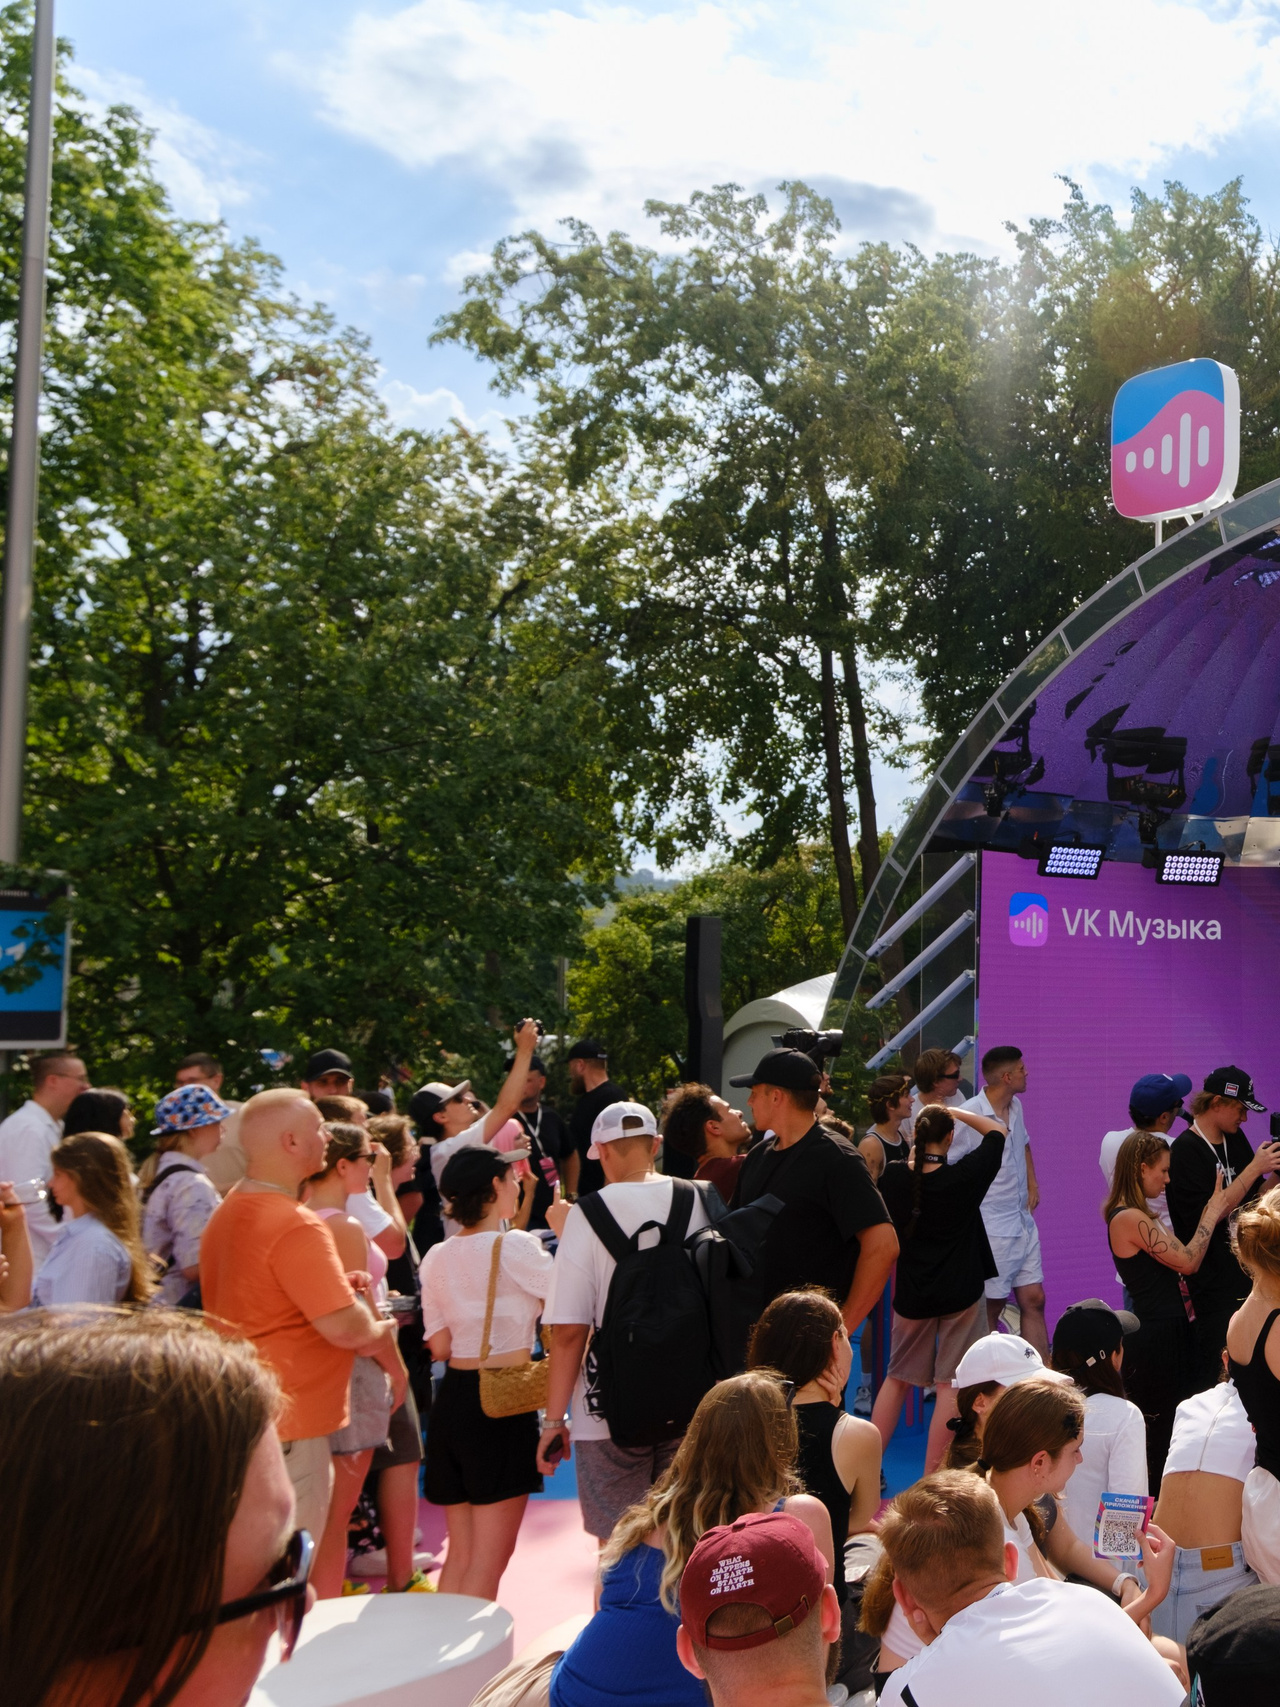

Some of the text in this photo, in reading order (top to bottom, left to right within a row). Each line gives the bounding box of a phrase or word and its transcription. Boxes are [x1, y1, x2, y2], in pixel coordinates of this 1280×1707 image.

[1062, 908, 1222, 946] VK Музыка
[712, 1560, 751, 1575] HAPPENS
[718, 1555, 743, 1567] WHAT
[710, 1566, 753, 1582] ON EARTH
[717, 1575, 744, 1587] STAYS
[710, 1578, 754, 1595] ON EARTH
